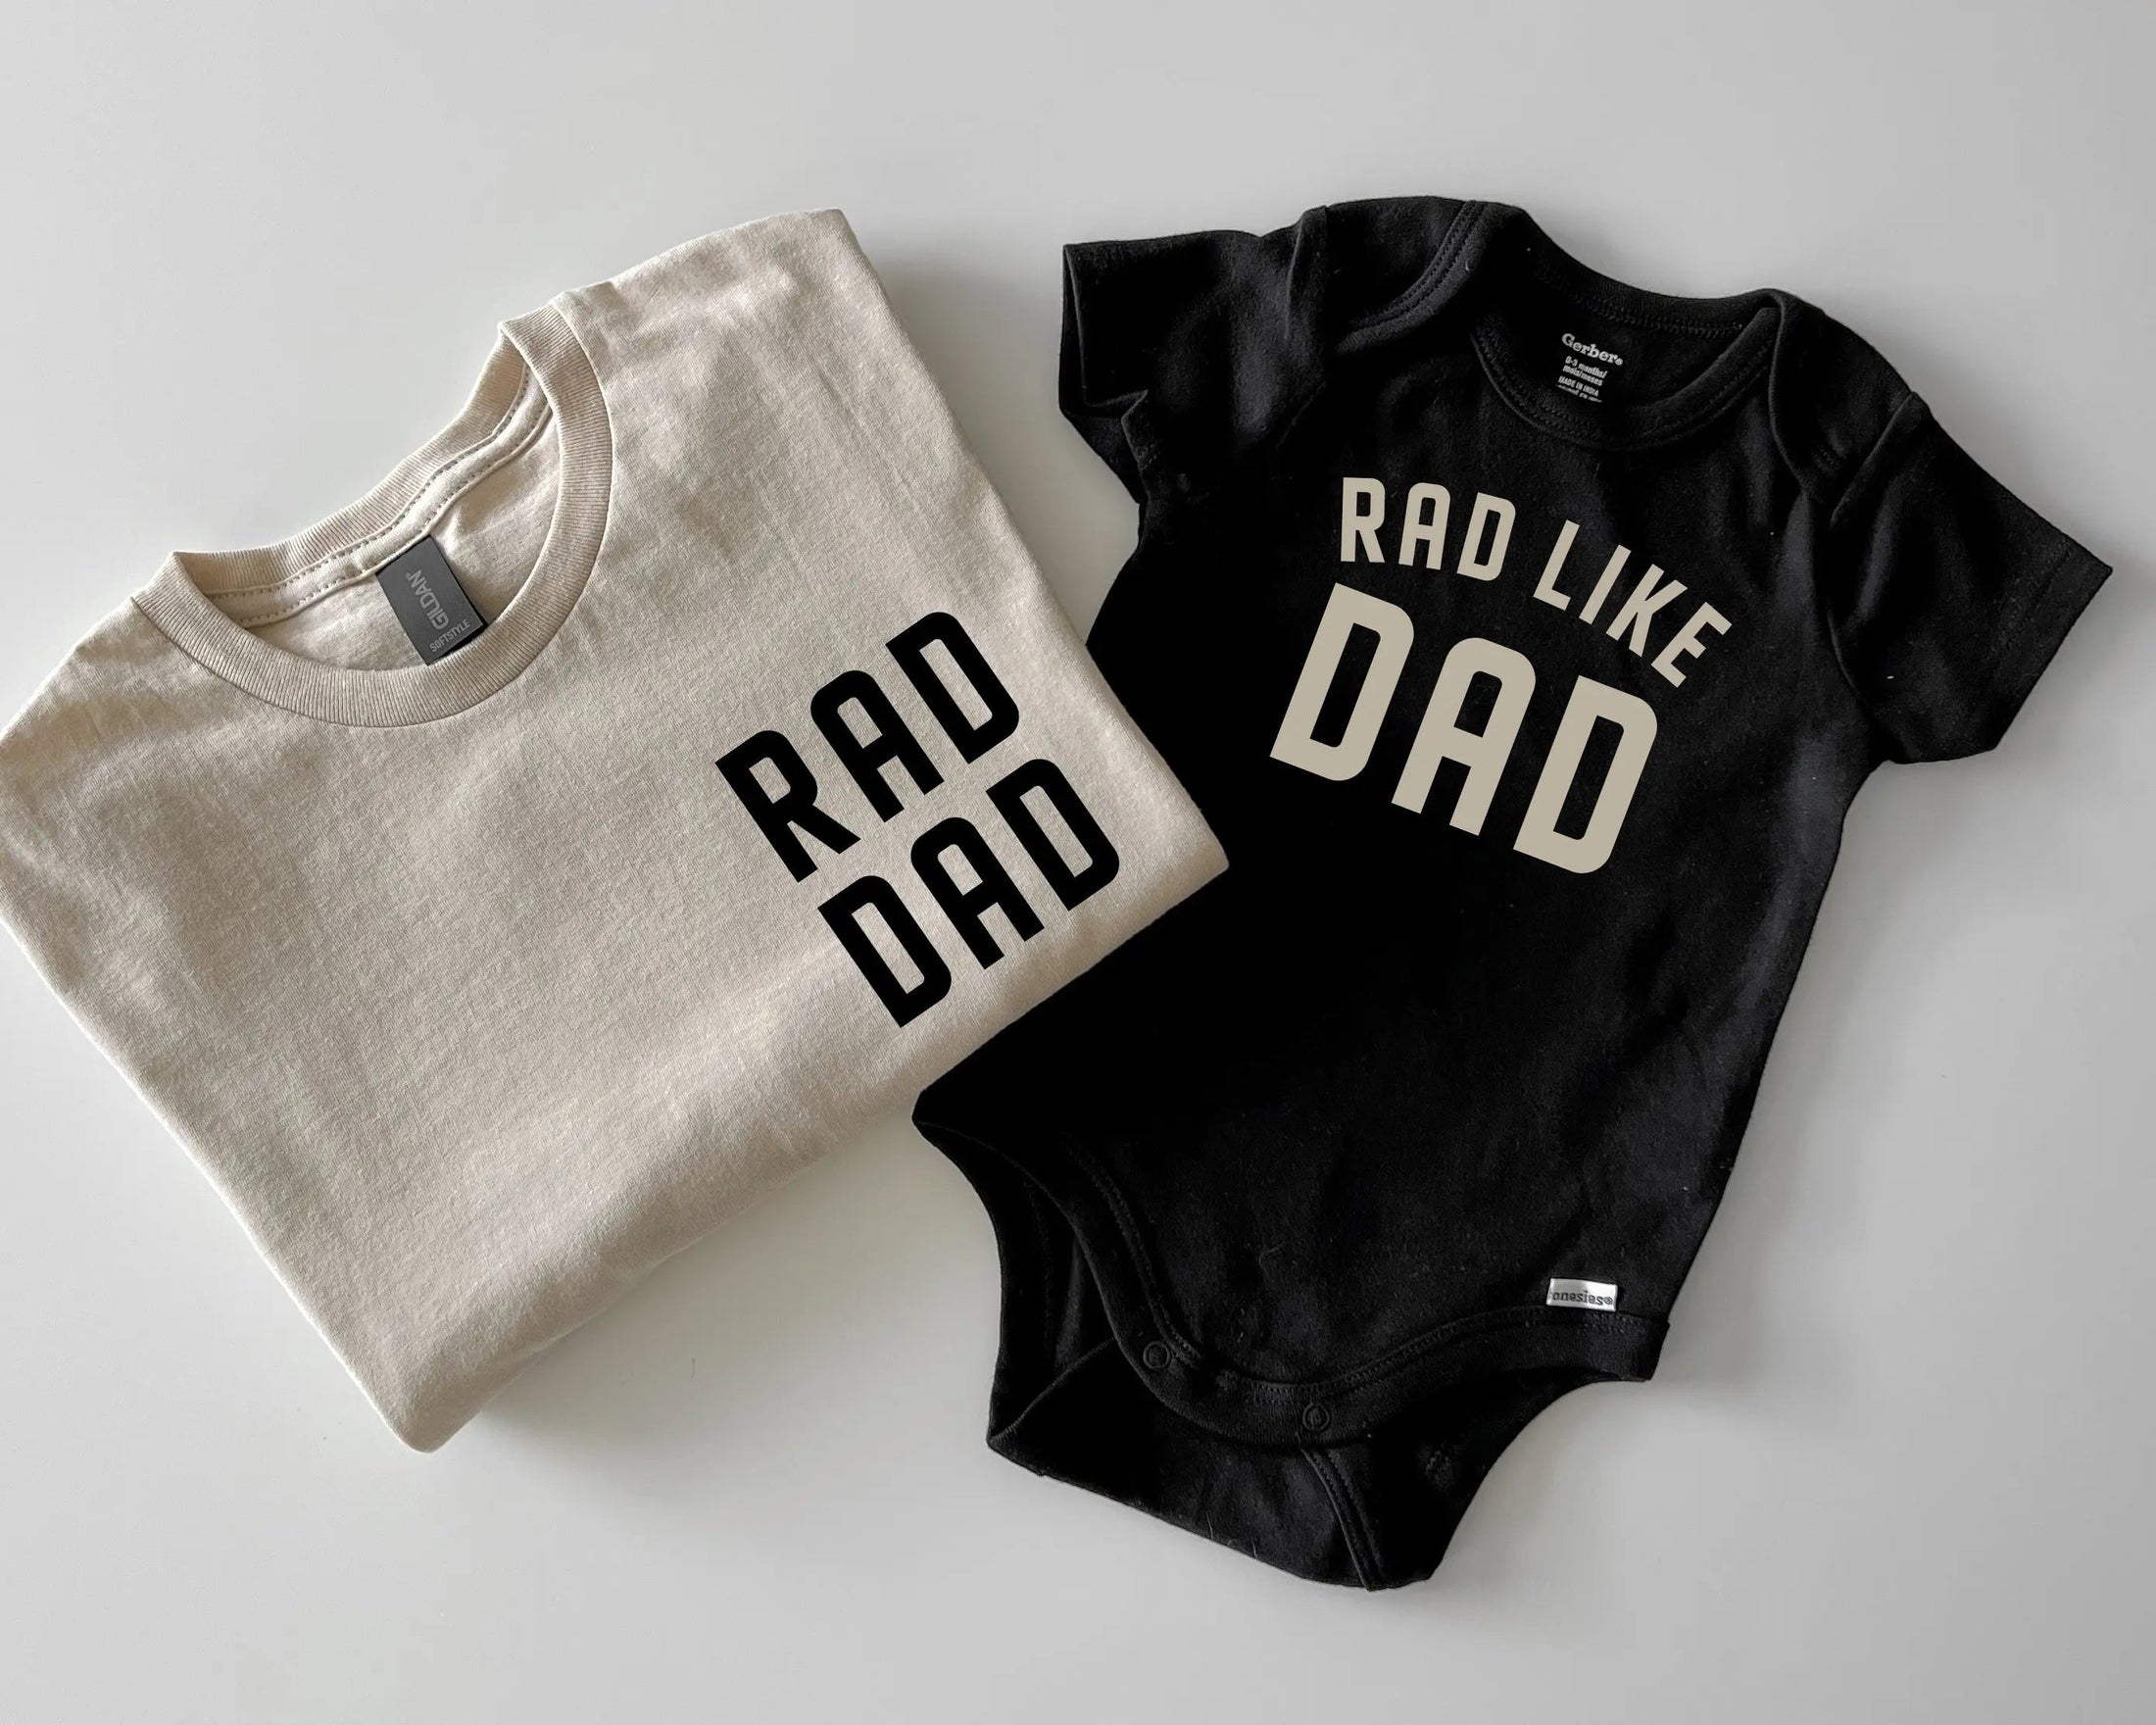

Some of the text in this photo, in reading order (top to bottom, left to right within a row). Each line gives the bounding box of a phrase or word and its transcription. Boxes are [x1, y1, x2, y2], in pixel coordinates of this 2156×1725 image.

[1557, 375, 1577, 388] MADE
[1575, 381, 1584, 391] IN
[1583, 384, 1599, 397] INDIA
[429, 618, 471, 653] SOFTSTYLE
[1341, 477, 1733, 688] RAD LIKE
[715, 612, 1019, 883] RAD
[1270, 583, 1658, 874] DAD
[817, 759, 1120, 1028] DAD
